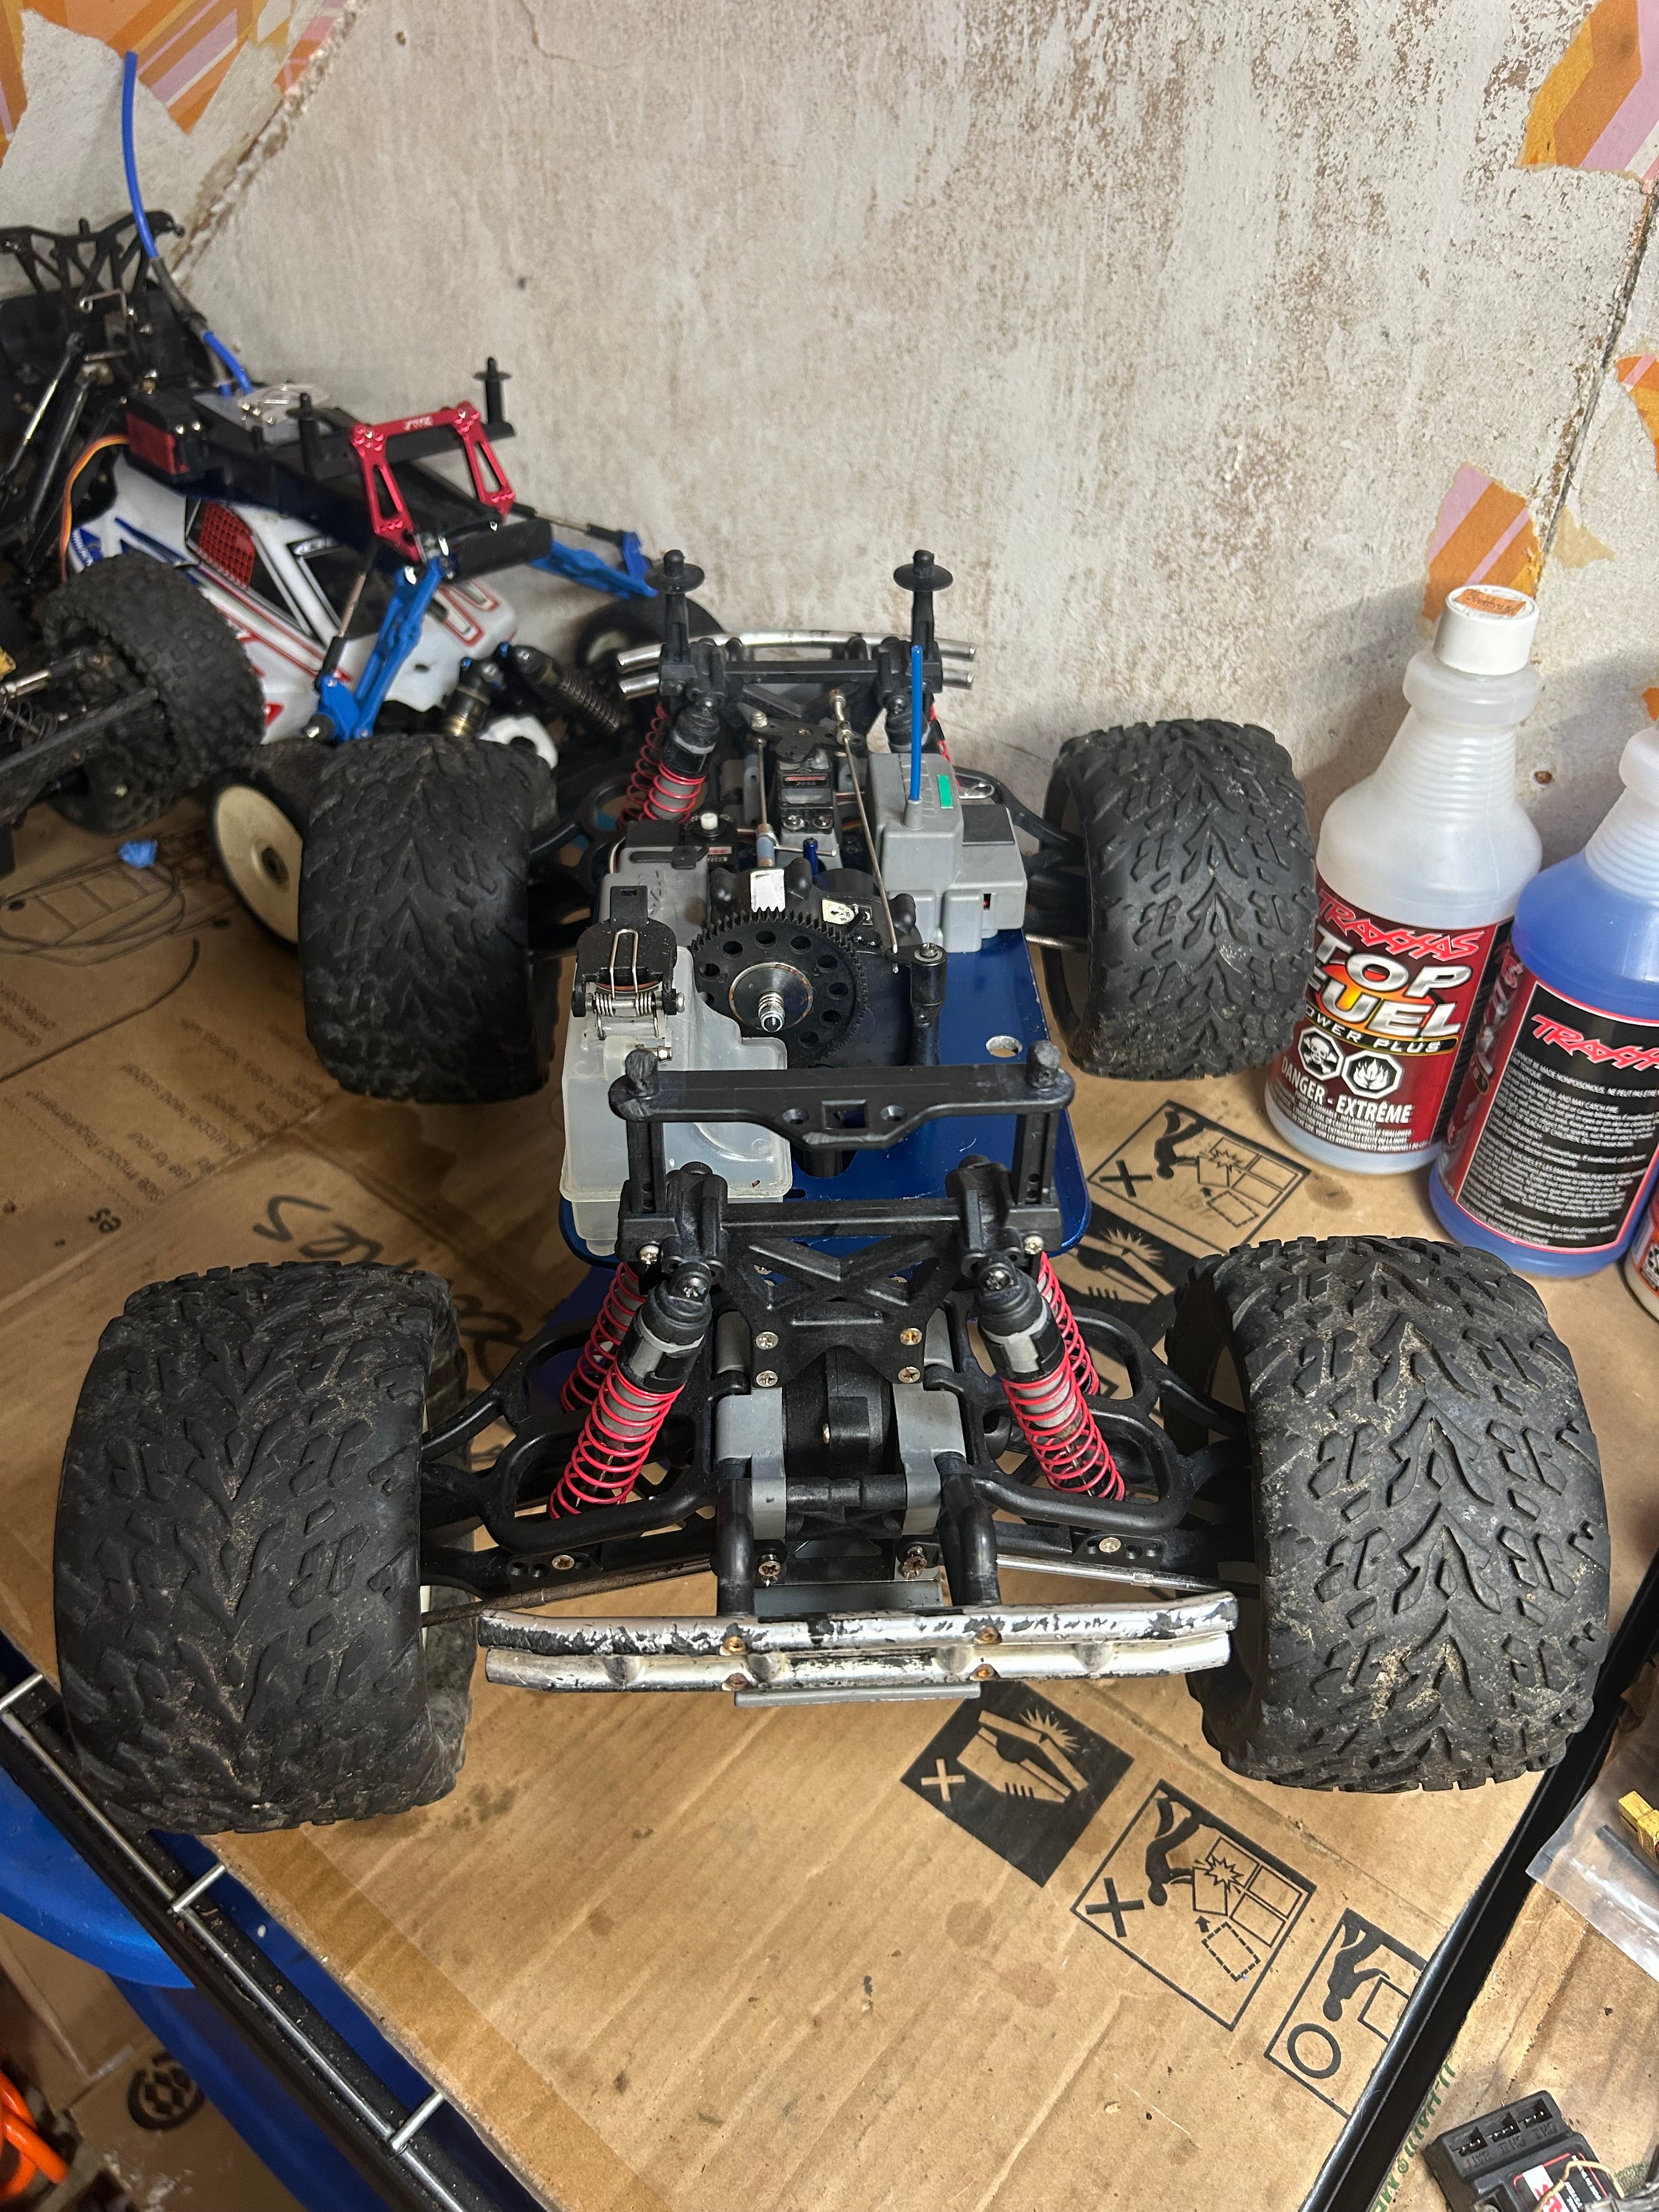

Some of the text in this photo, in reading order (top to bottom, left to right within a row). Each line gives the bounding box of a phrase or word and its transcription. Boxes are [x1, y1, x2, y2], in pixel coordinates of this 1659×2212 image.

[1318, 888, 1485, 962] TRAXXAS
[1315, 925, 1473, 999] TOP
[1306, 1003, 1442, 1053] OWER PLUS
[1531, 1013, 1659, 1071] TRAXX
[1281, 1055, 1327, 1106] DANGER
[1336, 1094, 1414, 1124] EXTRÊME
